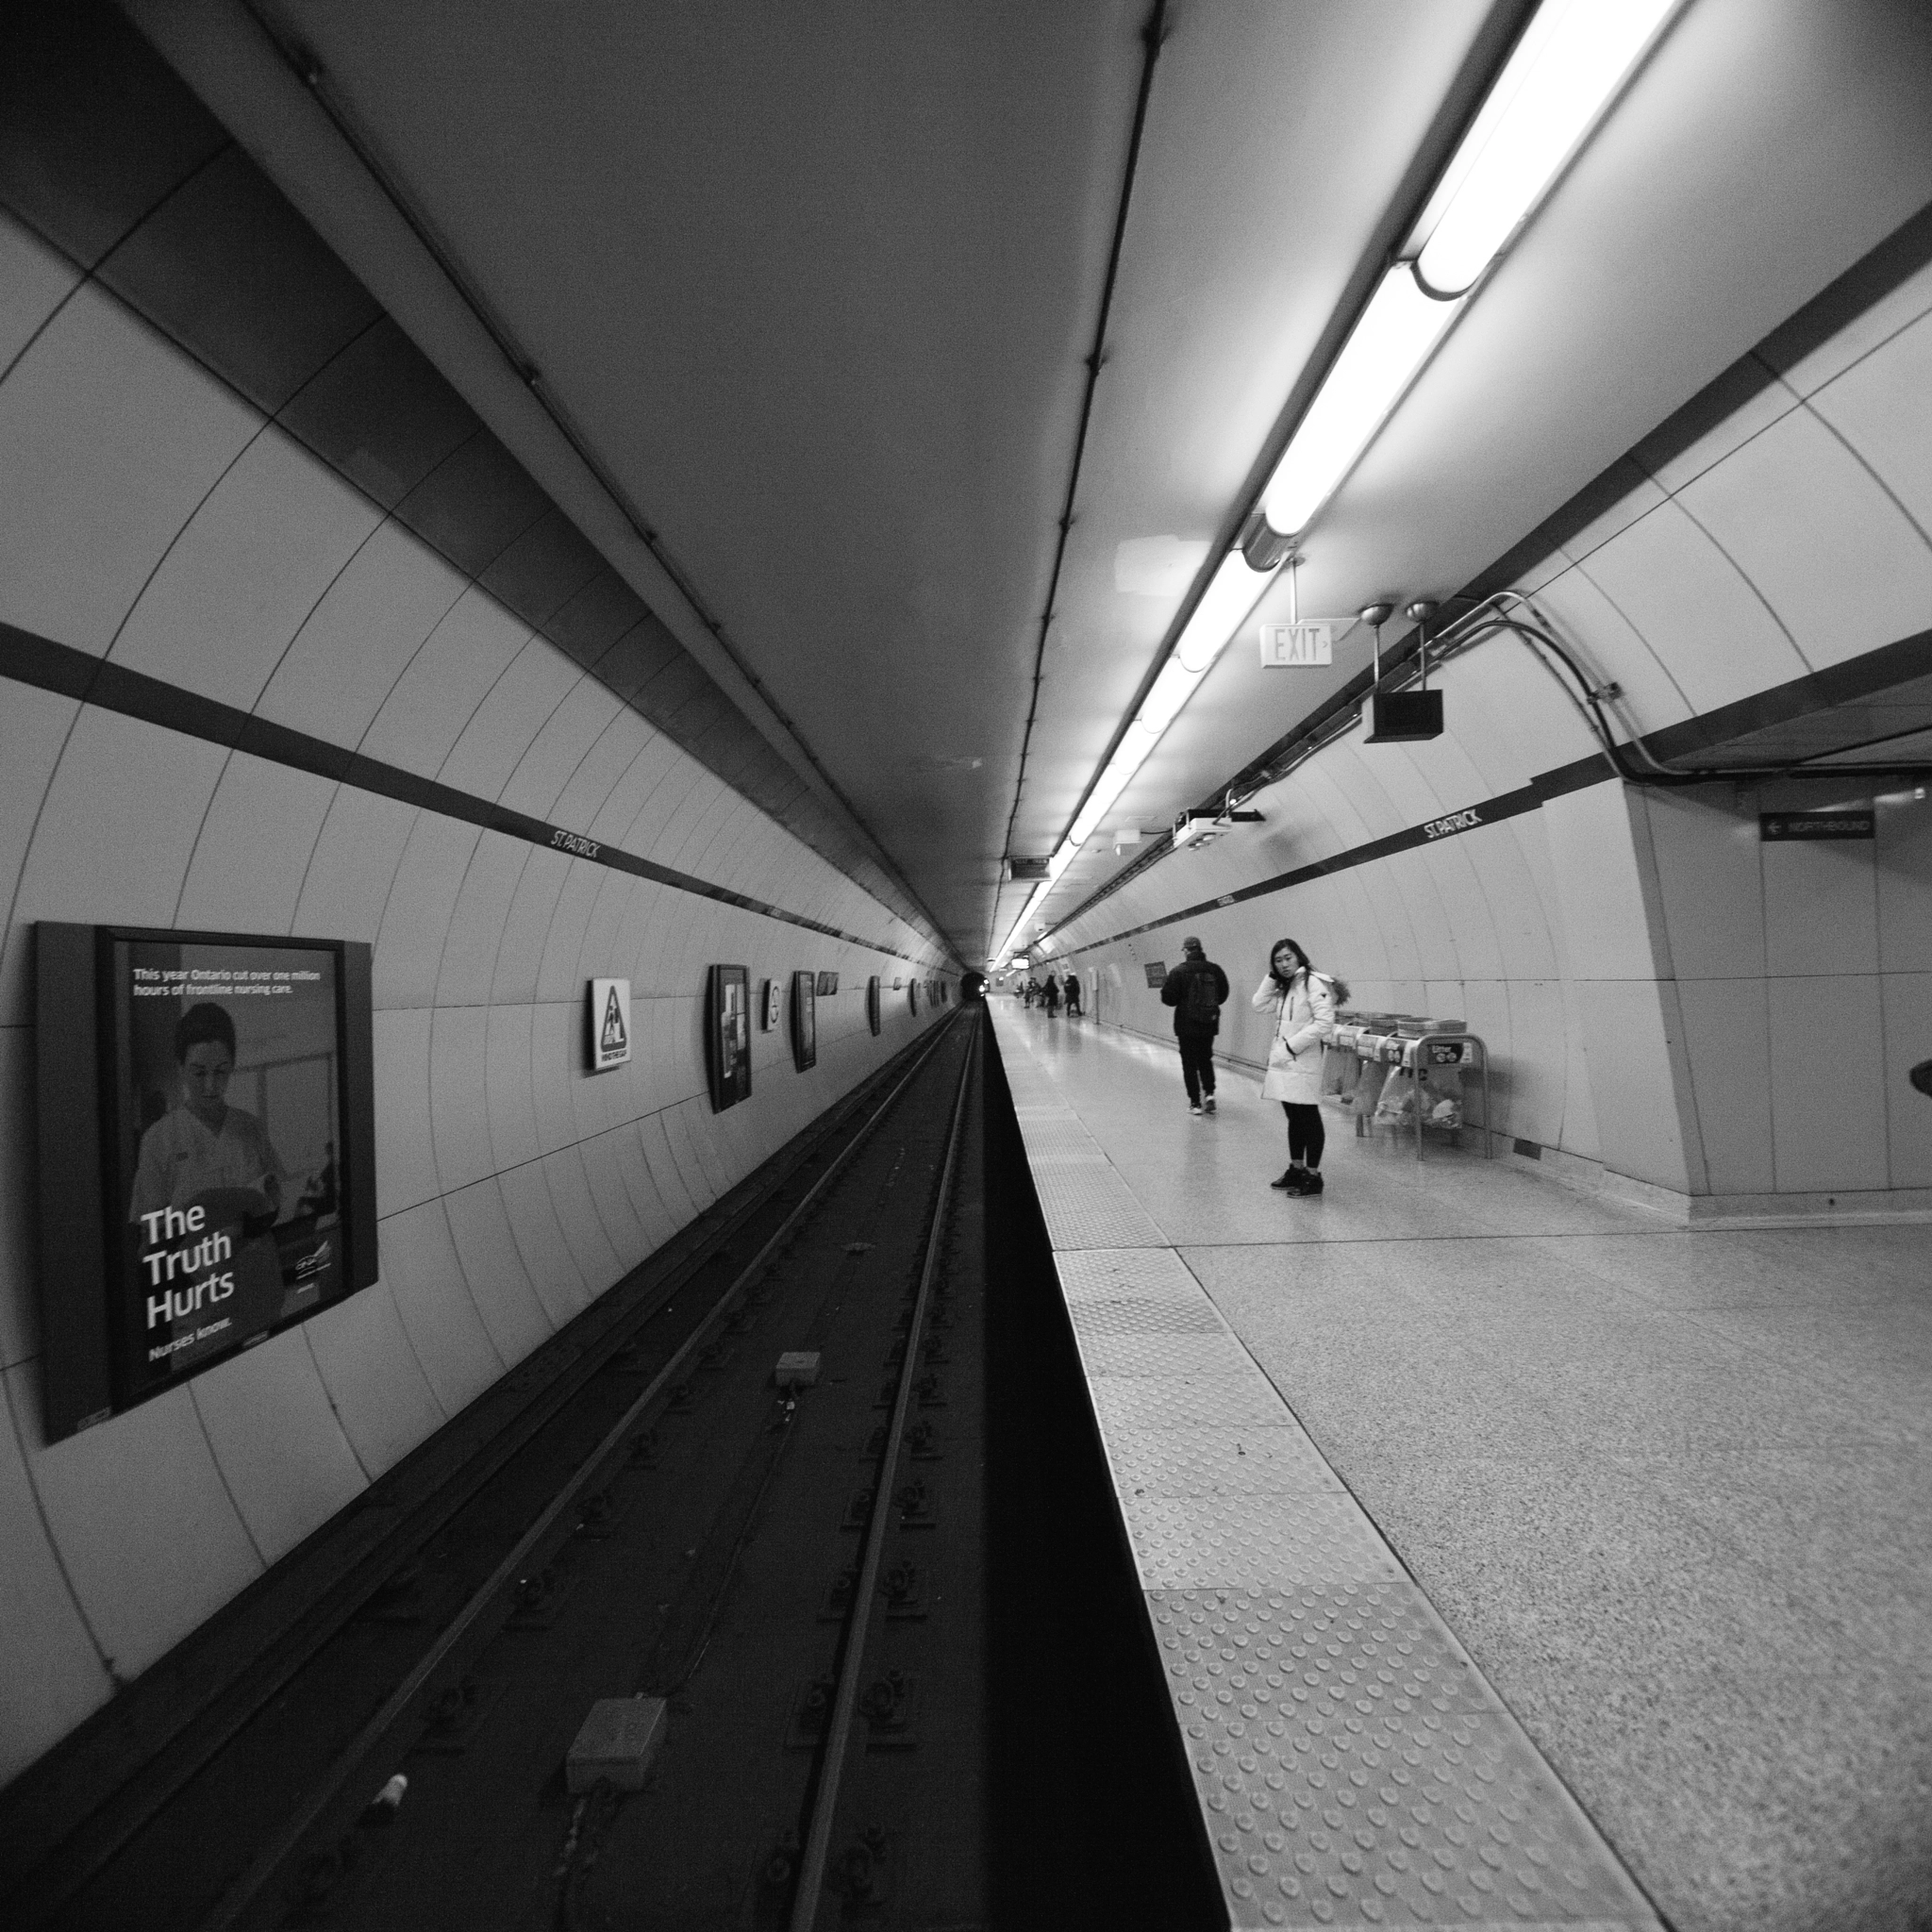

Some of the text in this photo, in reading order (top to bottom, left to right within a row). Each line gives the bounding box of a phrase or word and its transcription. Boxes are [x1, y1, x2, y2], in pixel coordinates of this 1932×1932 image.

[1274, 627, 1321, 661] EXIT
[132, 968, 321, 983] This year Ontario cut over one million
[133, 984, 170, 996] hours
[171, 983, 185, 995] of
[186, 983, 233, 995] frontline
[234, 983, 271, 996] nursing
[141, 1205, 206, 1244] The
[142, 1231, 232, 1286] Truth
[147, 1271, 234, 1329] Hurts
[149, 1333, 195, 1362] Nurses
